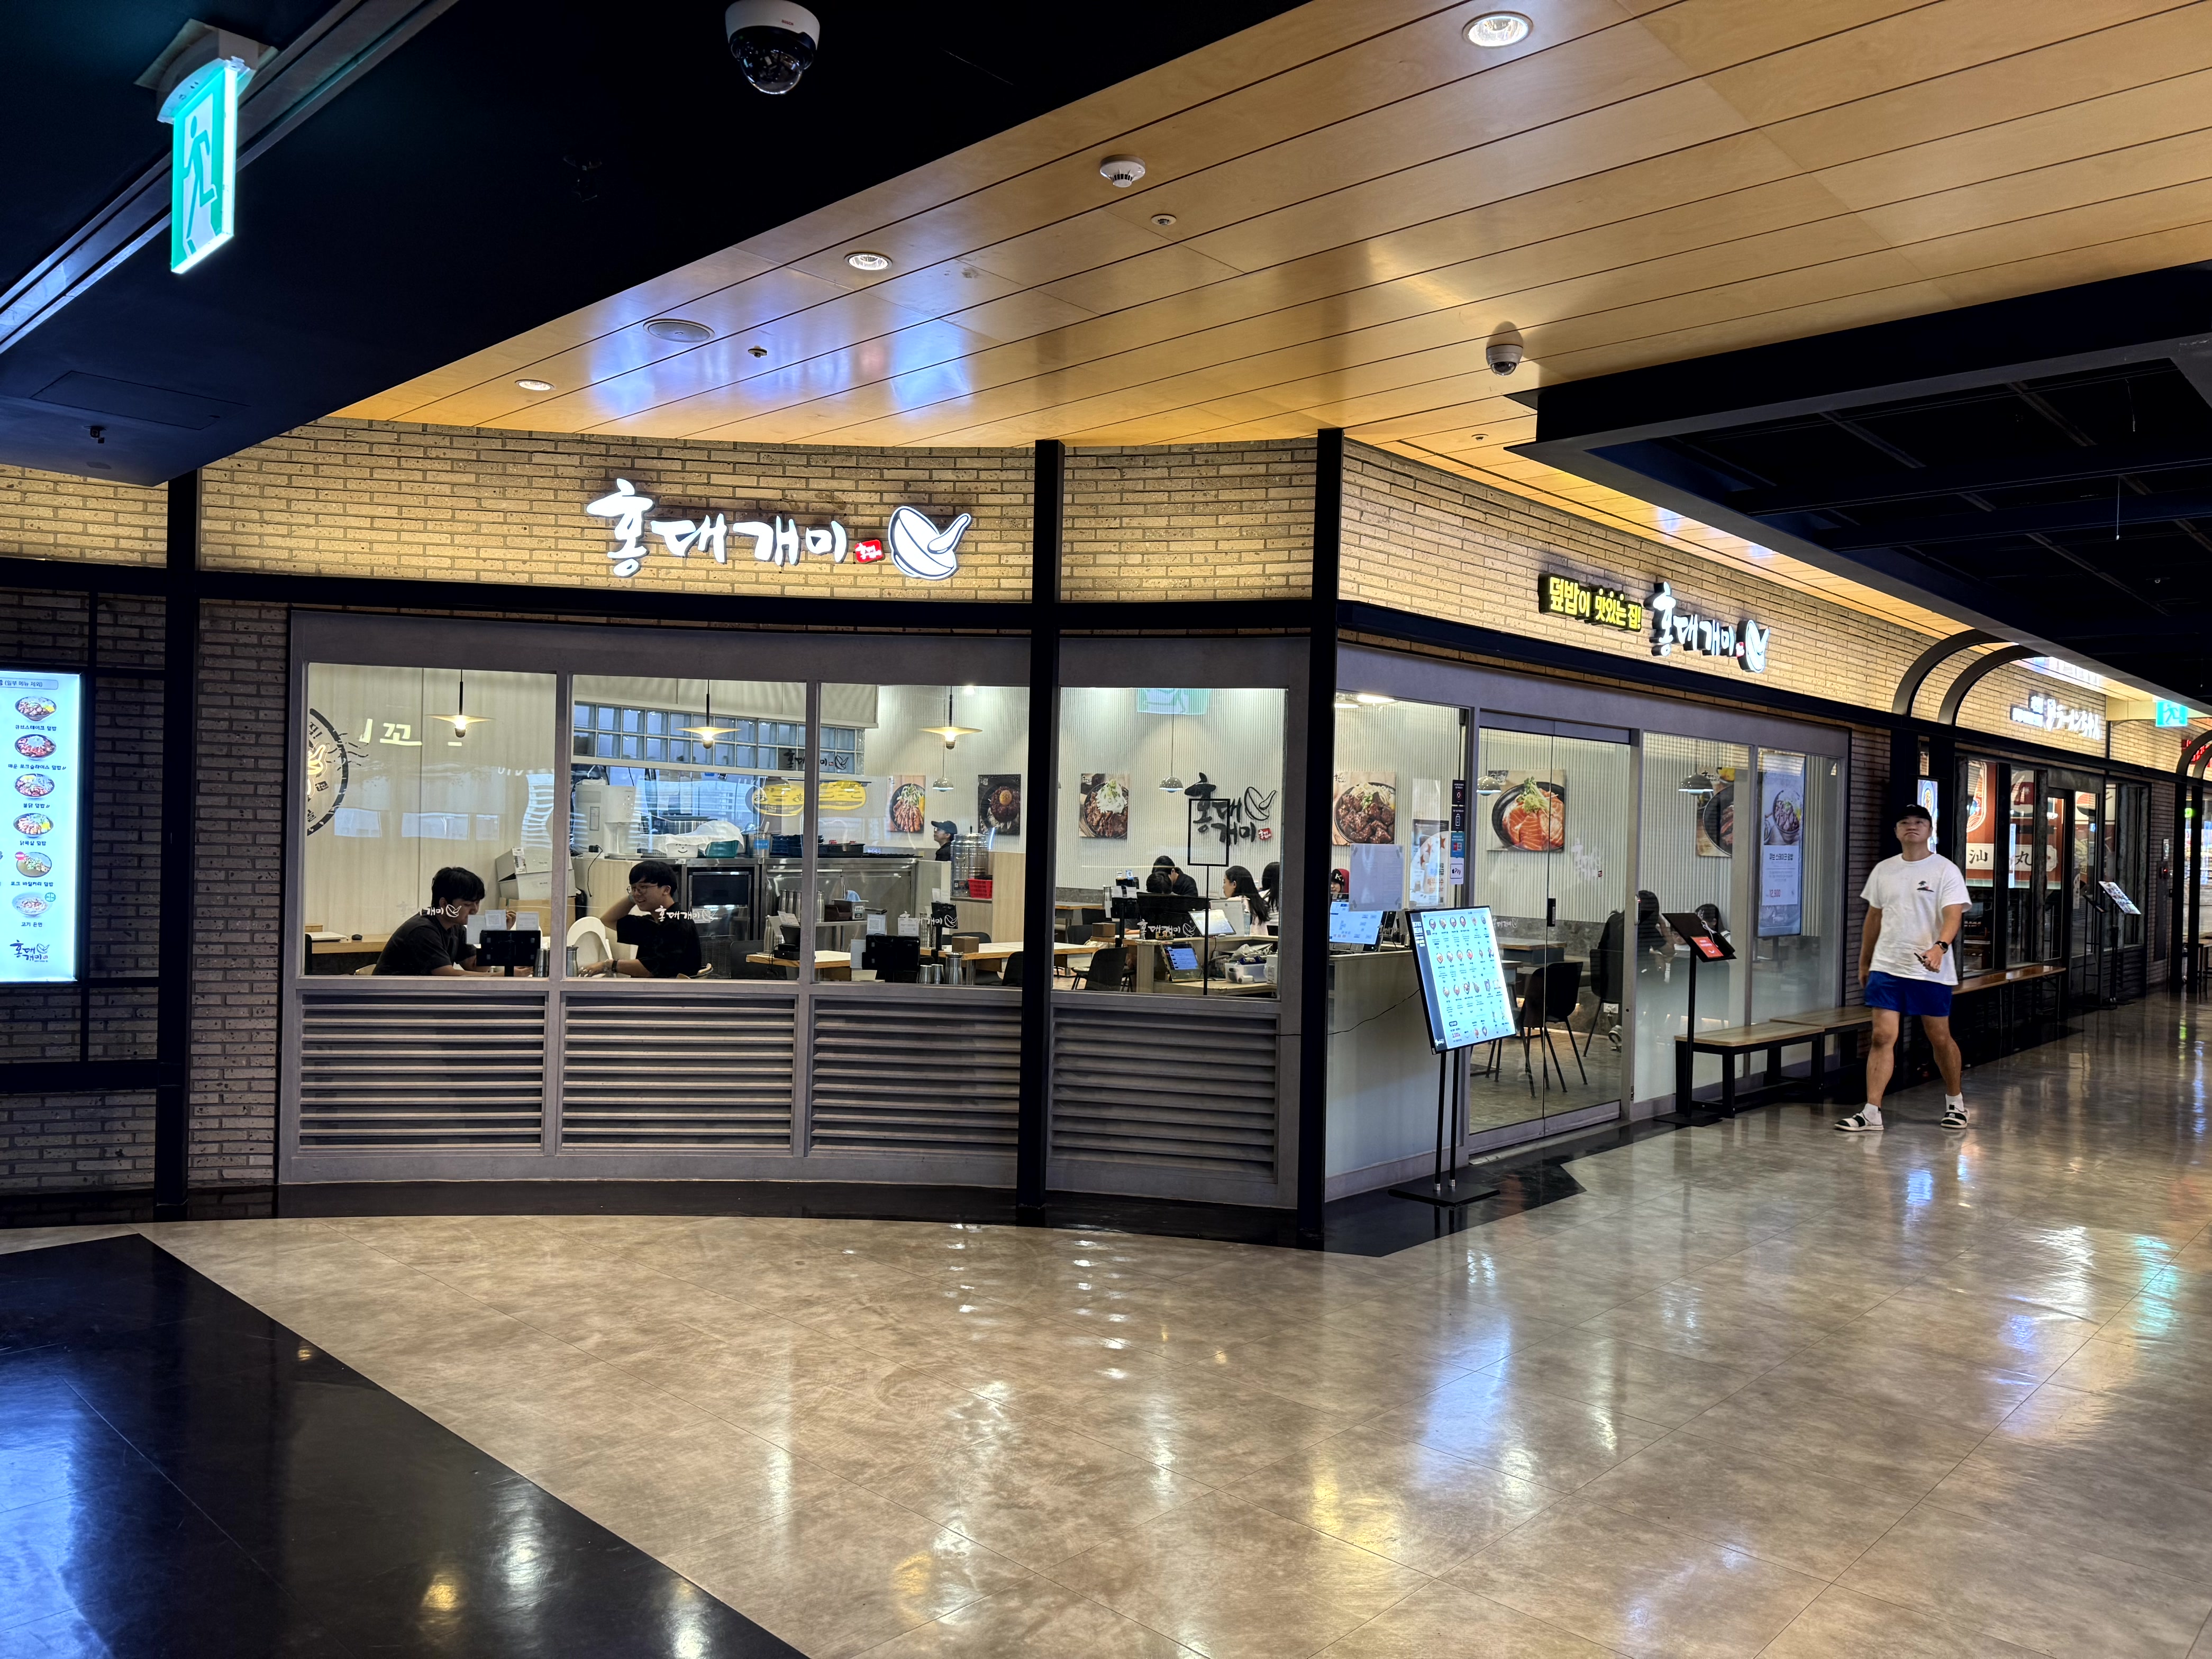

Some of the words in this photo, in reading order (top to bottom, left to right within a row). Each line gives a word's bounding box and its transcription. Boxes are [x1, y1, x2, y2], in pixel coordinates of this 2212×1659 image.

[587, 478, 848, 578] 홍대개미
[1550, 577, 1590, 617] 덮밥이
[1595, 594, 1627, 626] 맛있는
[1627, 603, 1642, 630] 집!
[1653, 581, 1734, 657] 홍대개미
[1969, 849, 1988, 864] 汕
[655, 905, 700, 922] 홍대개미
[10, 940, 35, 958] 홍대
